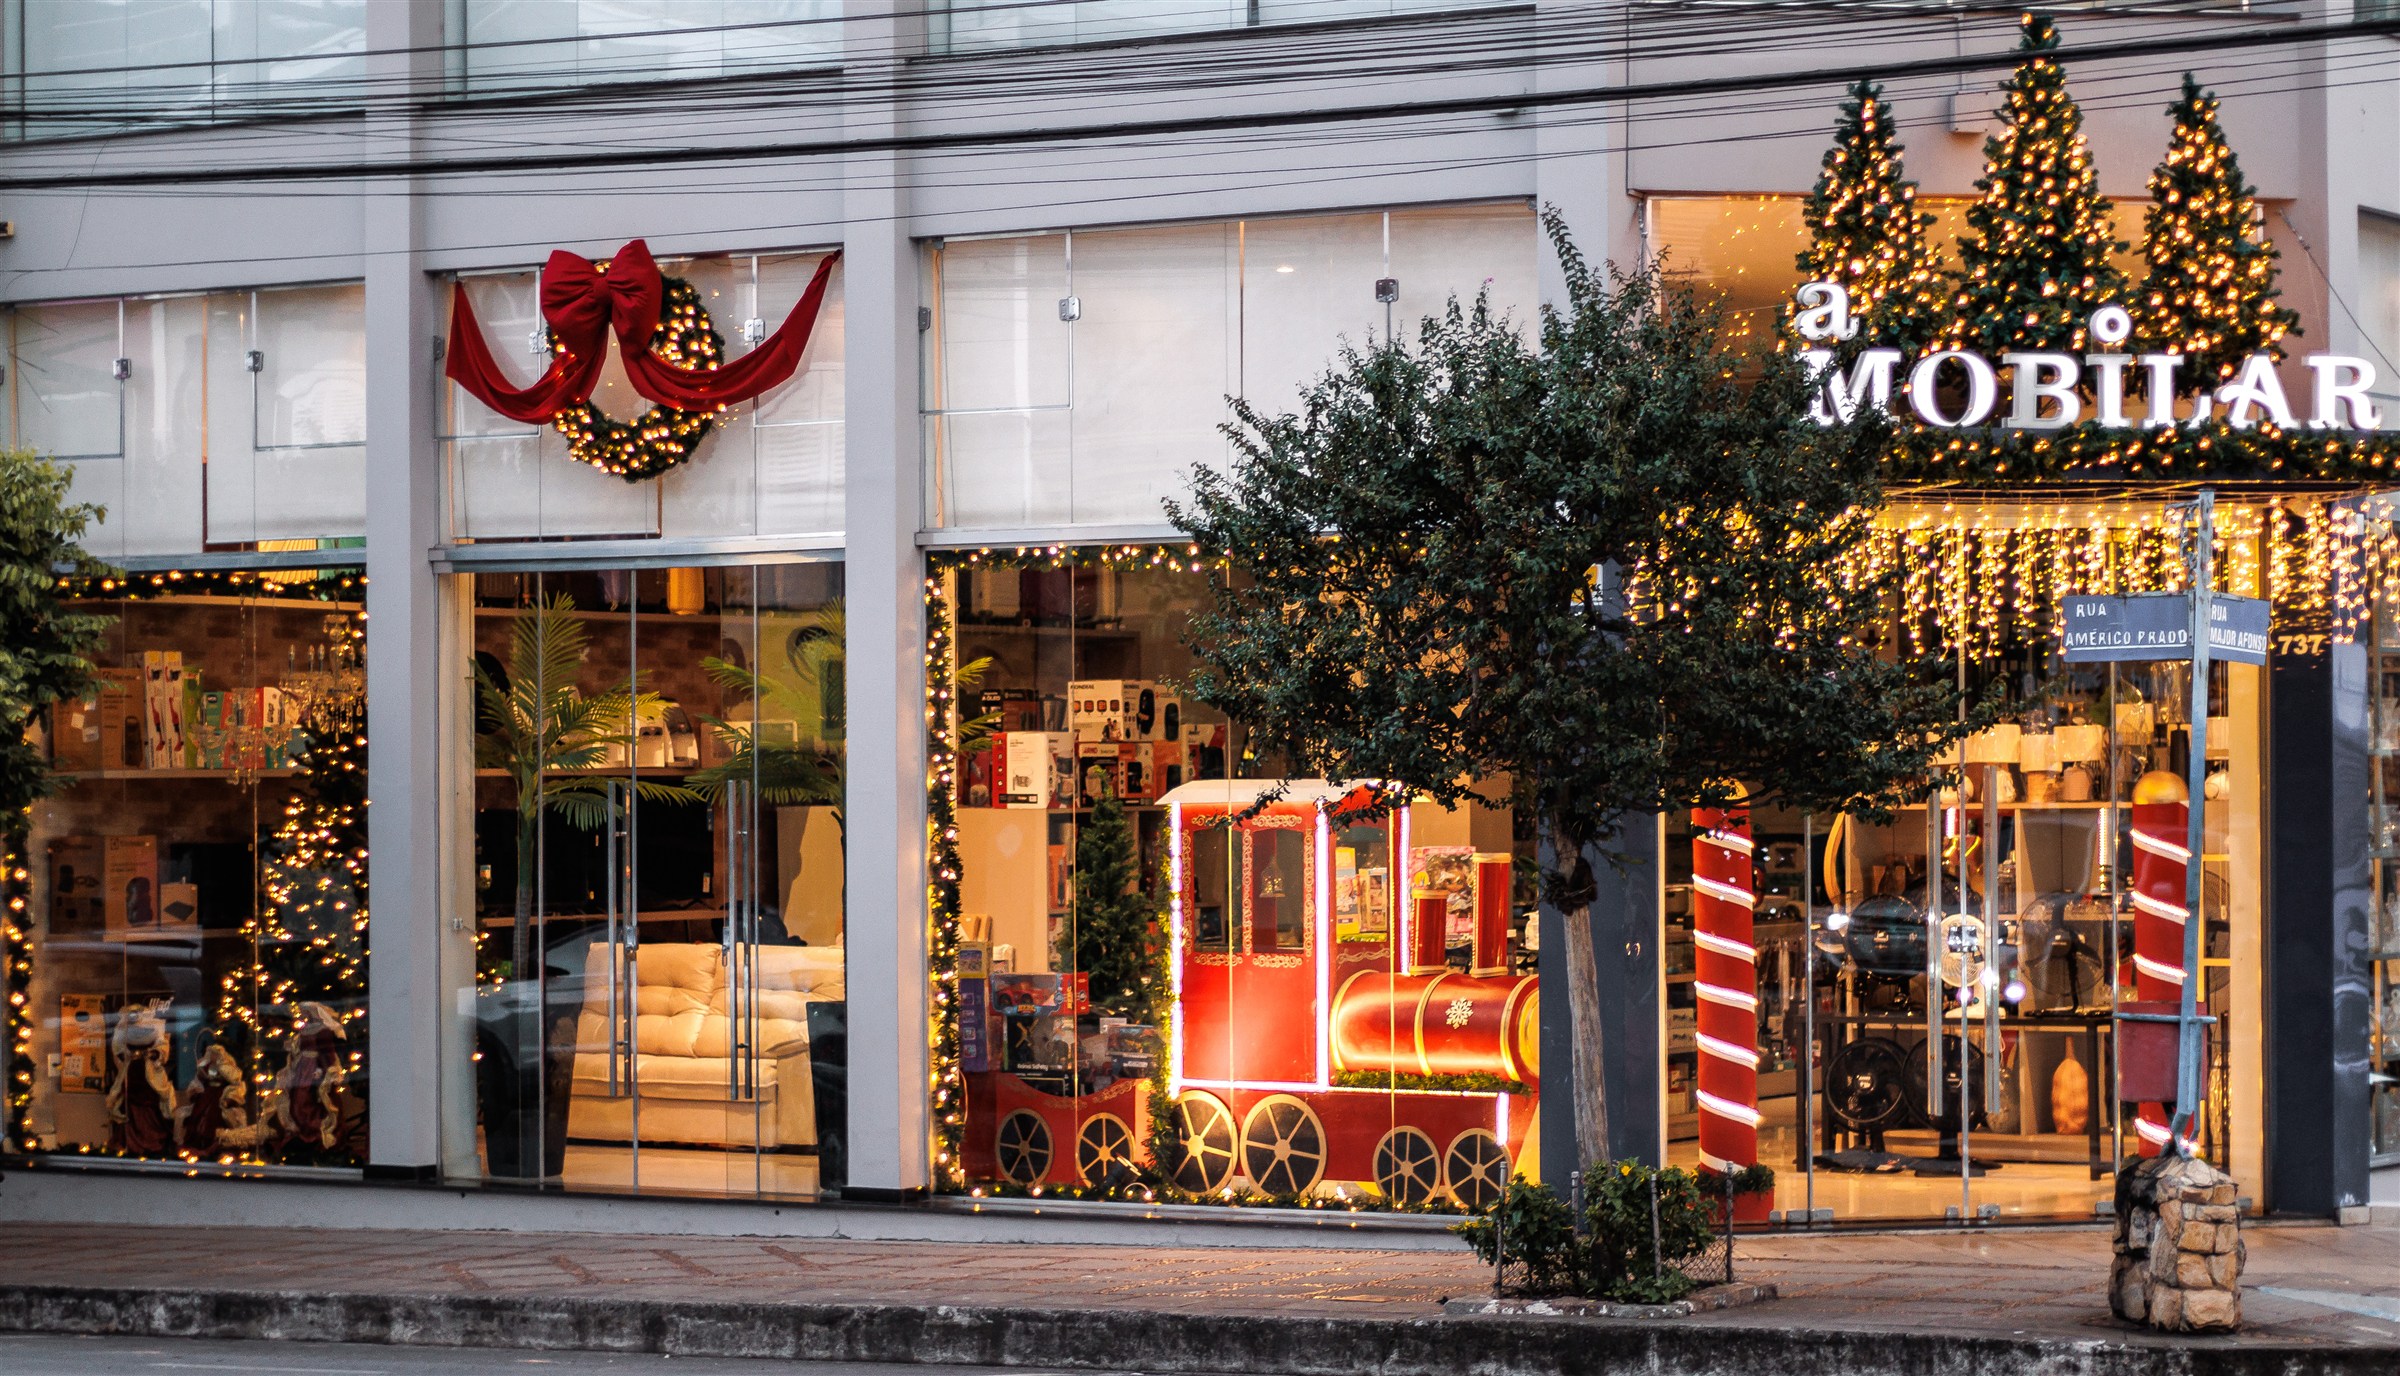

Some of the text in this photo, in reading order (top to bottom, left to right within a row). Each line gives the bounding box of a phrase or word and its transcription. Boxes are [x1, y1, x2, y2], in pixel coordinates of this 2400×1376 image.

[1796, 282, 1859, 342] a
[2076, 603, 2107, 618] RUA
[2211, 604, 2228, 621] RUA
[2065, 628, 2188, 646] AMÉRICO PRADO
[2209, 627, 2267, 652] MAJOR AFONSO
[2277, 633, 2324, 656] 737
